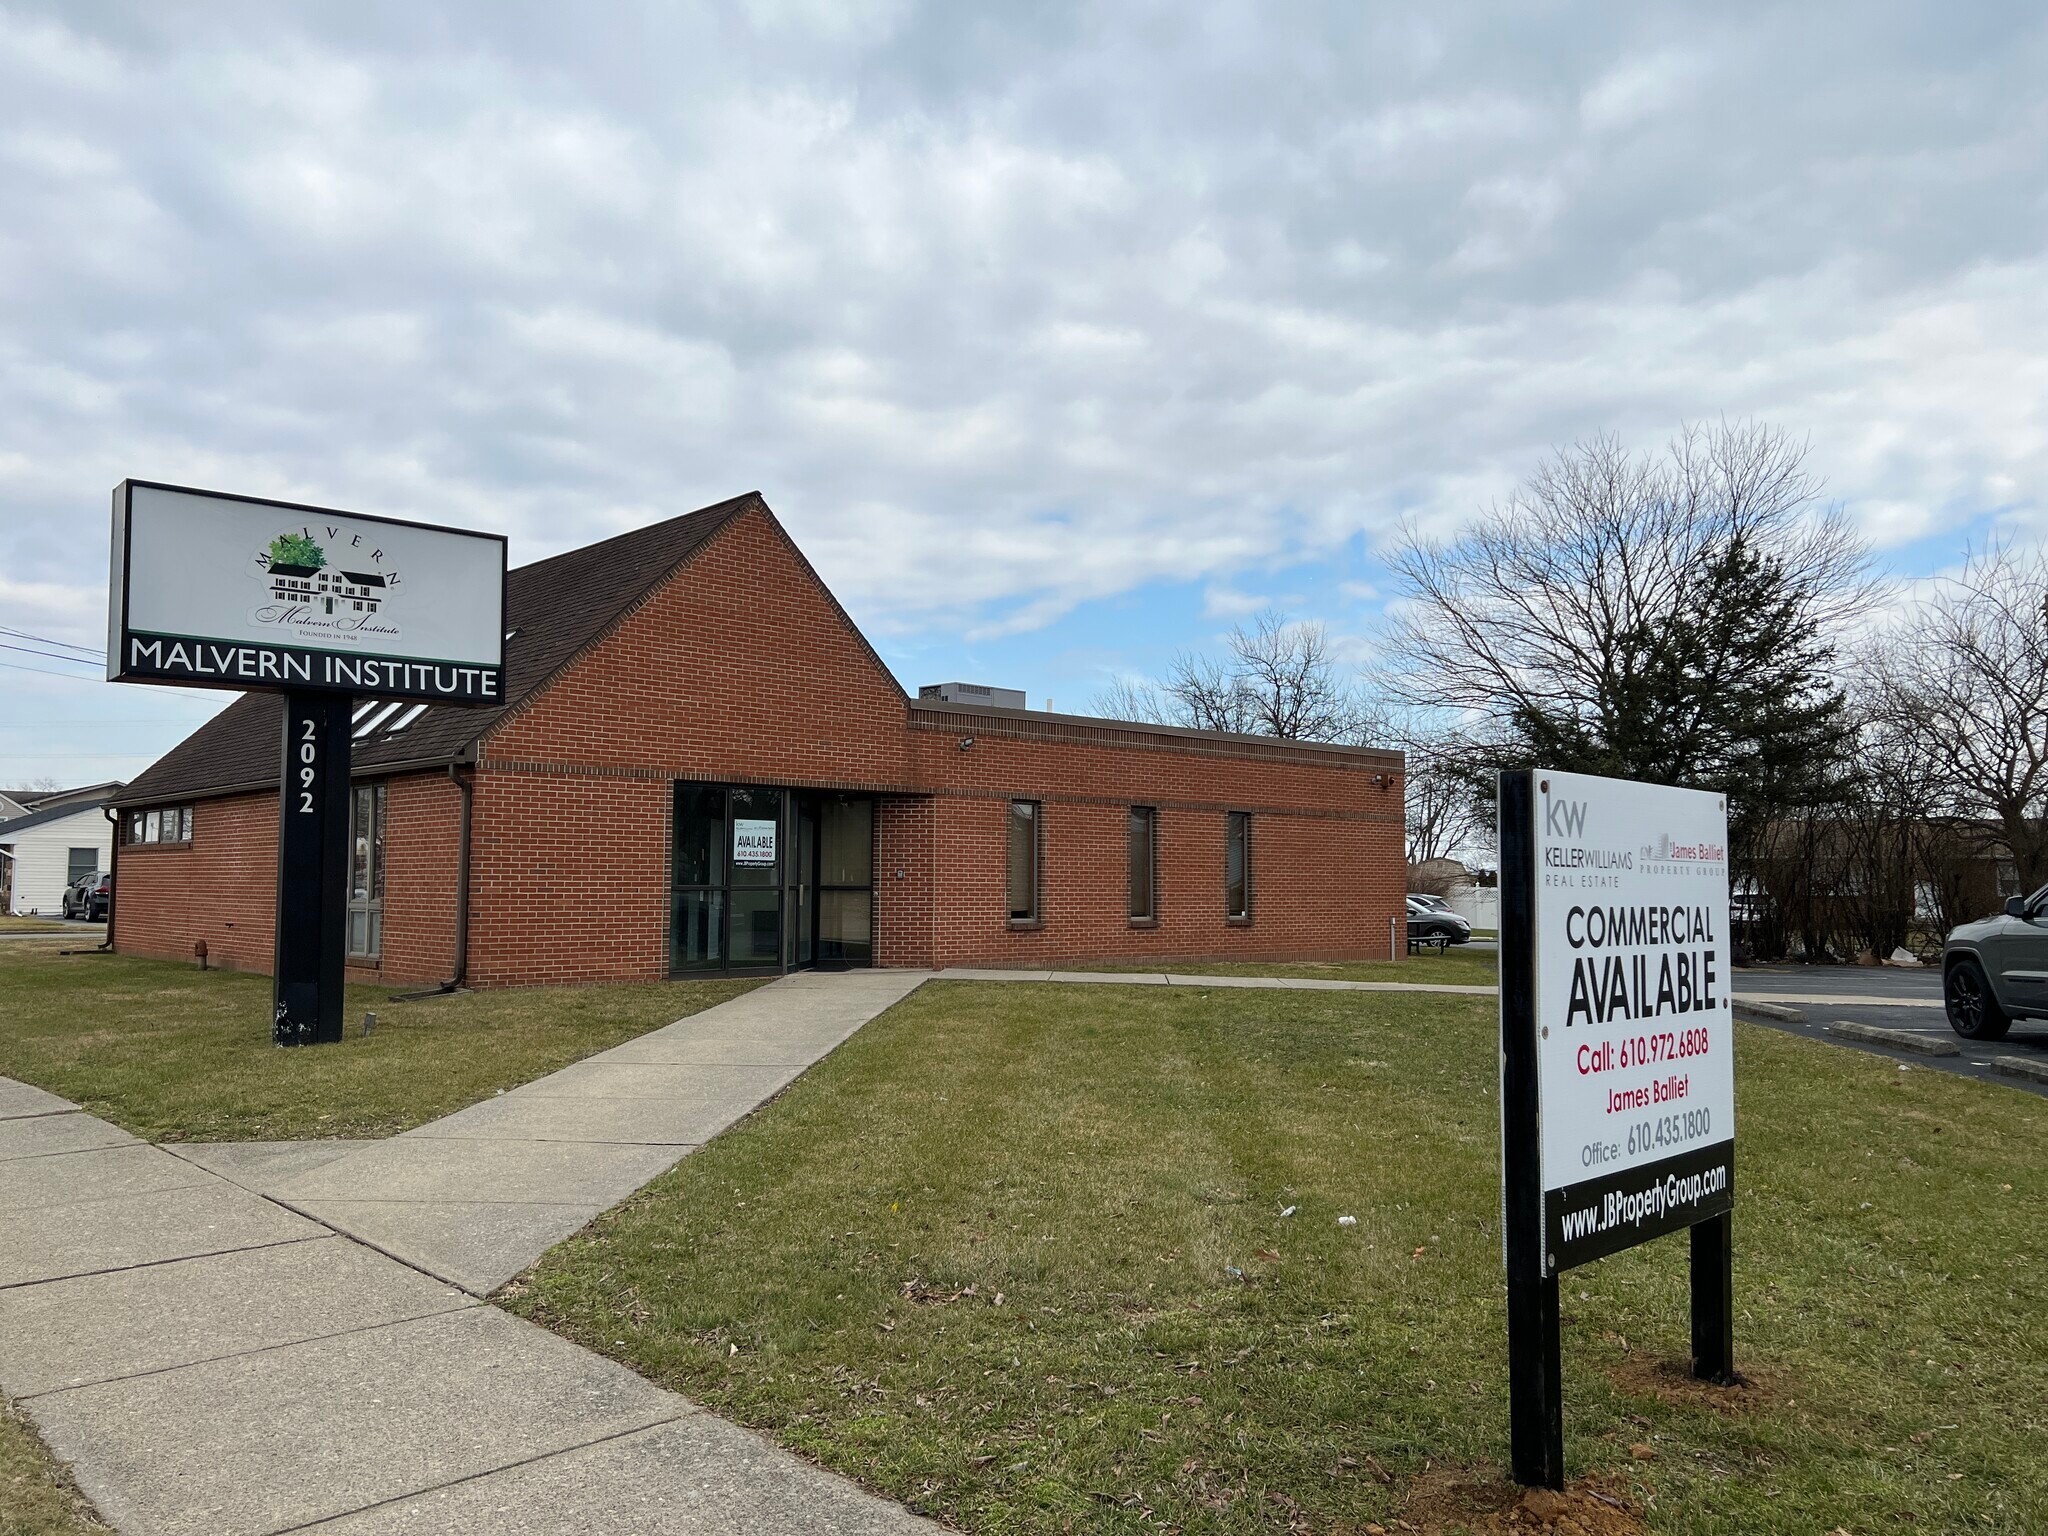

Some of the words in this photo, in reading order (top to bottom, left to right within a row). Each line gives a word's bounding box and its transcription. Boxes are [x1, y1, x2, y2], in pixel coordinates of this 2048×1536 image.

[255, 527, 401, 585] MALVERN
[255, 605, 331, 628] Malvern
[332, 612, 400, 635] Institute
[300, 630, 332, 639] FOUNDED
[131, 638, 311, 681] MALVERN
[325, 656, 497, 696] INSTITUTE
[300, 719, 316, 813] 2092
[737, 836, 772, 848] AVAILABLE
[1671, 841, 1697, 859] James
[1699, 843, 1724, 861] Balliet
[1545, 874, 1574, 887] REAL
[1581, 875, 1619, 888] ESTATE
[1640, 864, 1690, 876] PROPERTY
[1697, 867, 1725, 877] GROUP
[1566, 905, 1714, 949] COMMERCIAL
[1566, 950, 1716, 1027] AVAILABLE
[1577, 1041, 1615, 1075] Call:
[1620, 1027, 1709, 1068] 610.972.6808
[1606, 1087, 1649, 1114] James
[1653, 1074, 1689, 1102] Balliet
[1582, 1142, 1621, 1167] Office:
[1627, 1107, 1711, 1156] 610.435.1800
[1562, 1164, 1726, 1242] www.JBPropertyGroup.com
